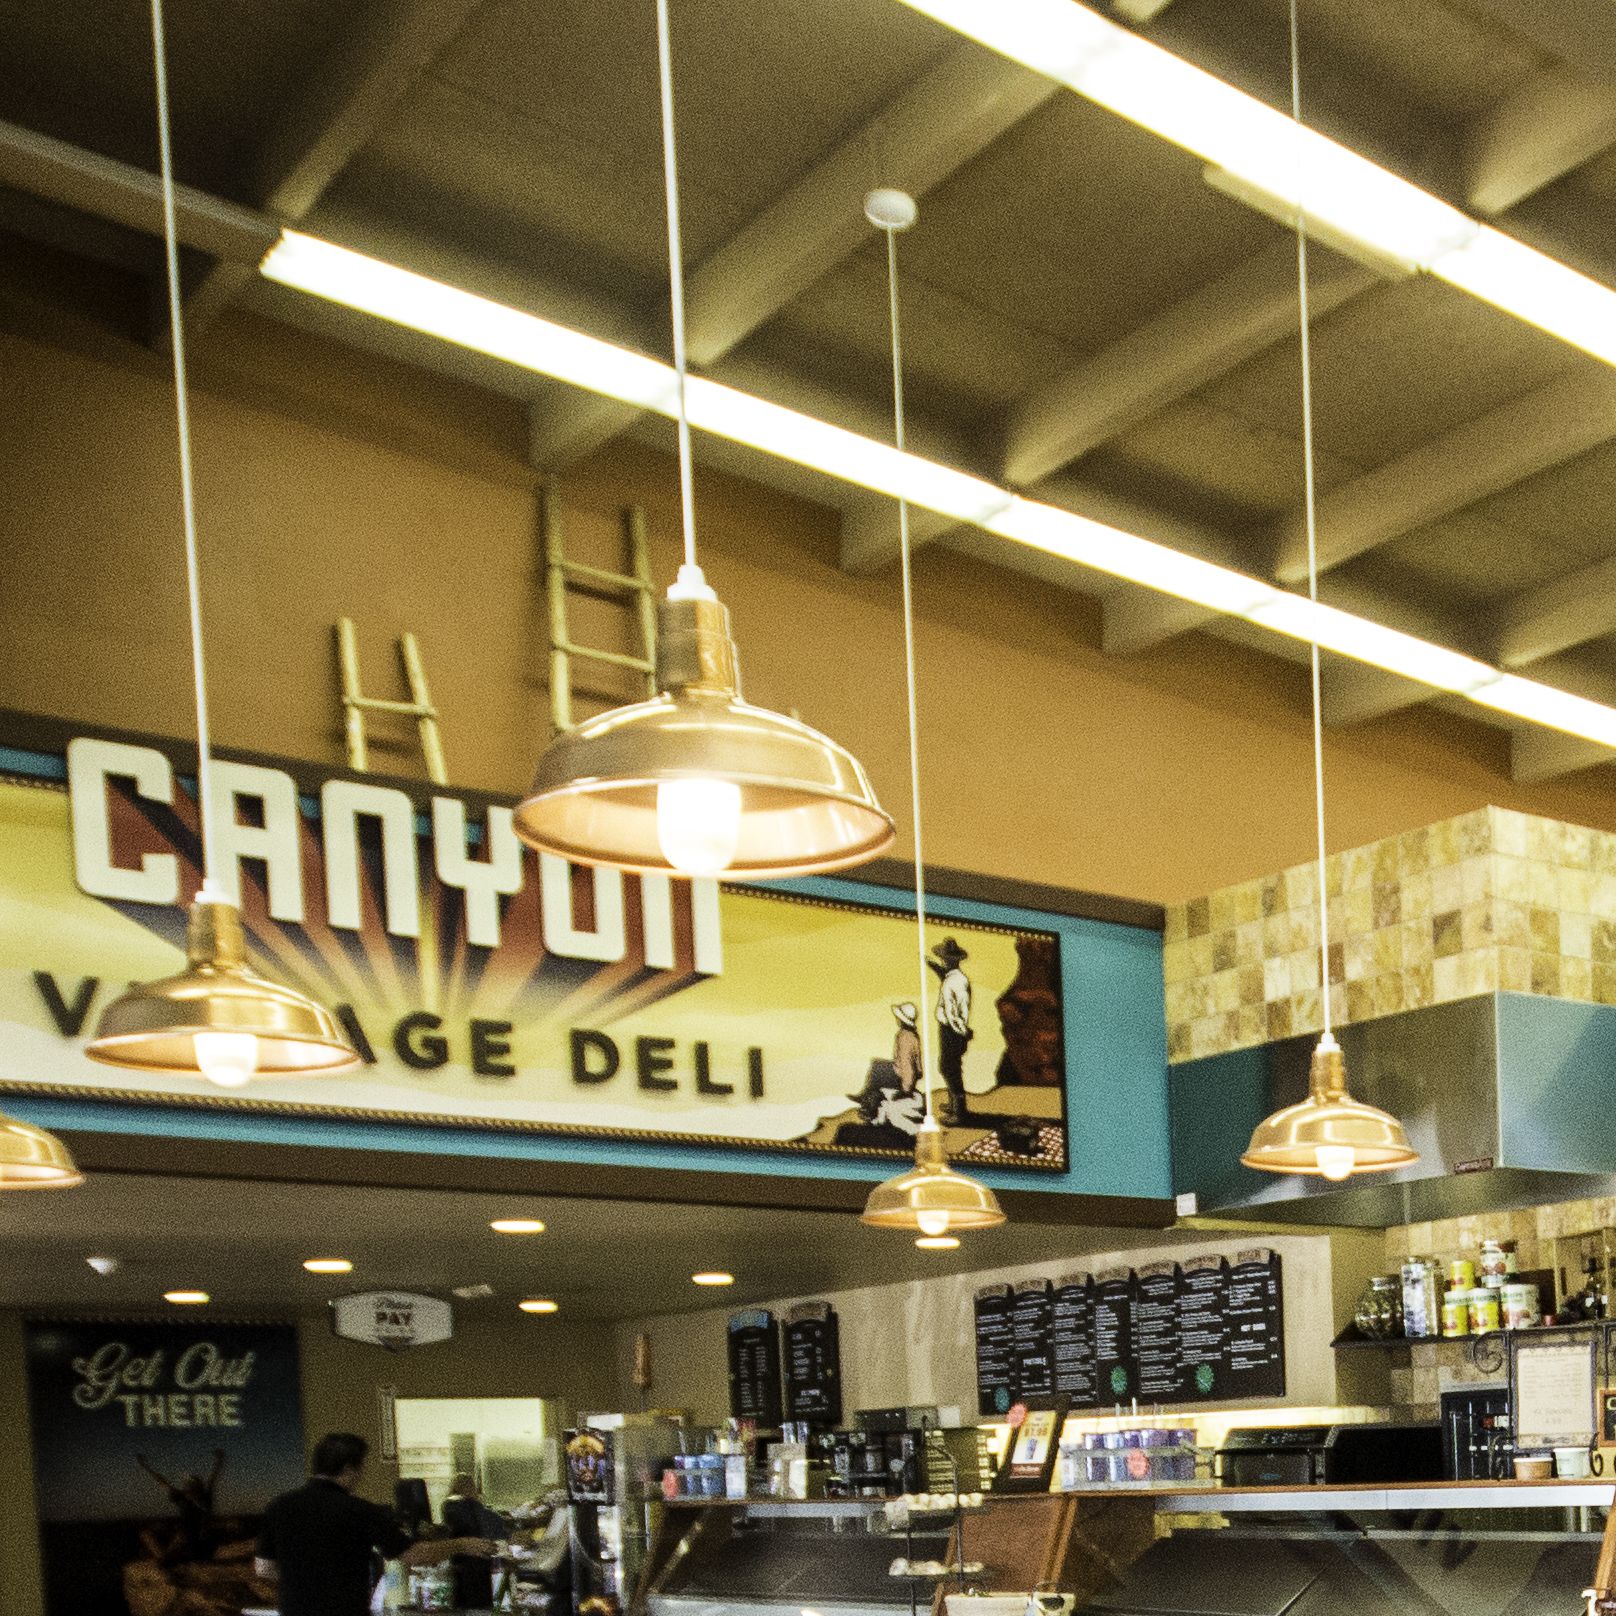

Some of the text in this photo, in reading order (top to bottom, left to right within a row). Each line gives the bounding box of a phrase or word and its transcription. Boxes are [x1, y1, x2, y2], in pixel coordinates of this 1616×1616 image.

[67, 737, 724, 977] CANYON
[569, 1027, 765, 1099] DELI
[375, 1312, 412, 1326] PAY
[72, 1342, 255, 1409] Get Out
[116, 1393, 243, 1428] THERE
